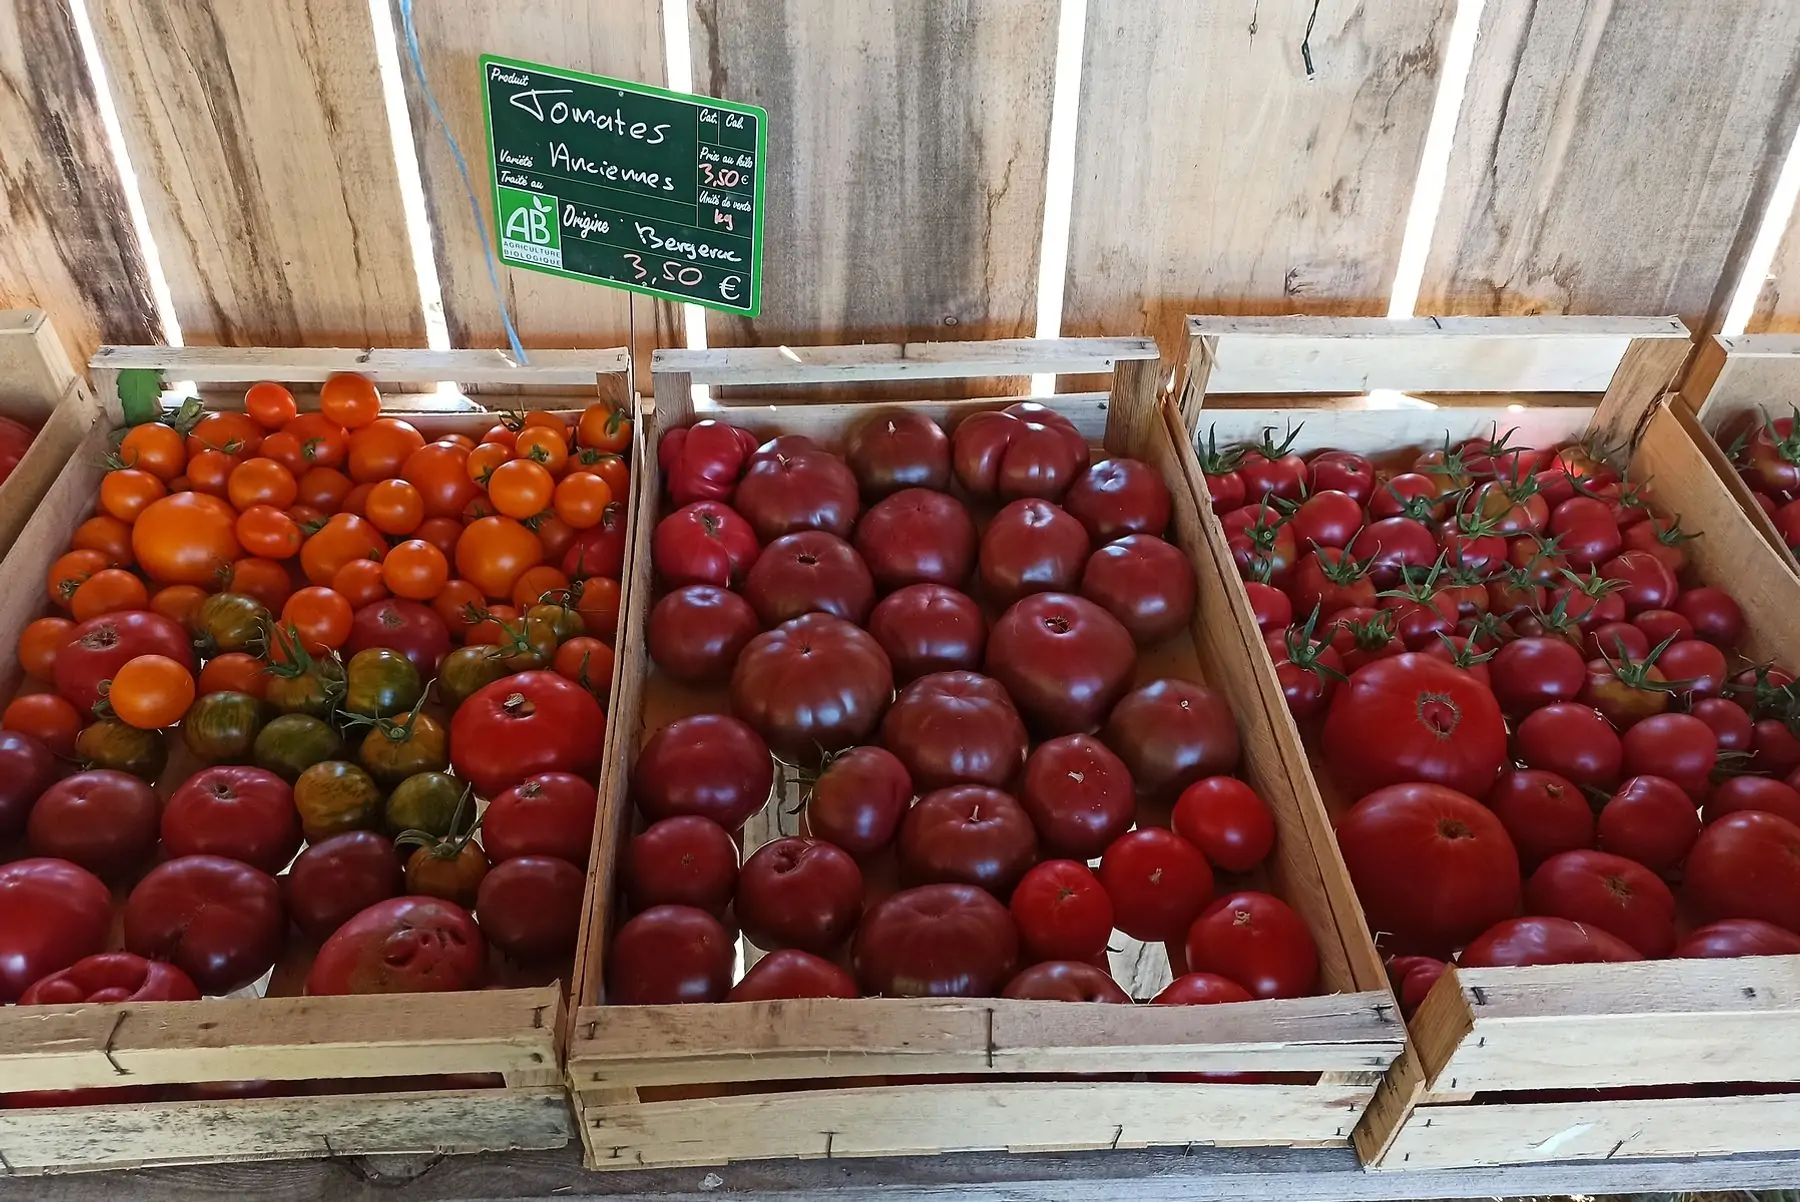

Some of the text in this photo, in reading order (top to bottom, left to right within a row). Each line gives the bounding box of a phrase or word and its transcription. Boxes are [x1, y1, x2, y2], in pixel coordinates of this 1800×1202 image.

[491, 67, 530, 87] Produit
[509, 88, 672, 145] Tomates
[699, 108, 718, 124] Cat.
[500, 148, 534, 168] Variété
[549, 141, 675, 192] Anciennes
[699, 146, 753, 169] Prix au kilo
[501, 170, 545, 190] Traité au
[698, 162, 750, 188] 3,50 €
[699, 190, 752, 213] Unité de vente
[505, 206, 552, 245] AB
[563, 203, 610, 239] Origine
[713, 208, 734, 231] kg
[503, 240, 561, 259] AGRICULTURE
[634, 221, 743, 263] Bergerac
[503, 248, 561, 266] BIOLOGIQUE
[623, 253, 742, 301] 3,50 €
